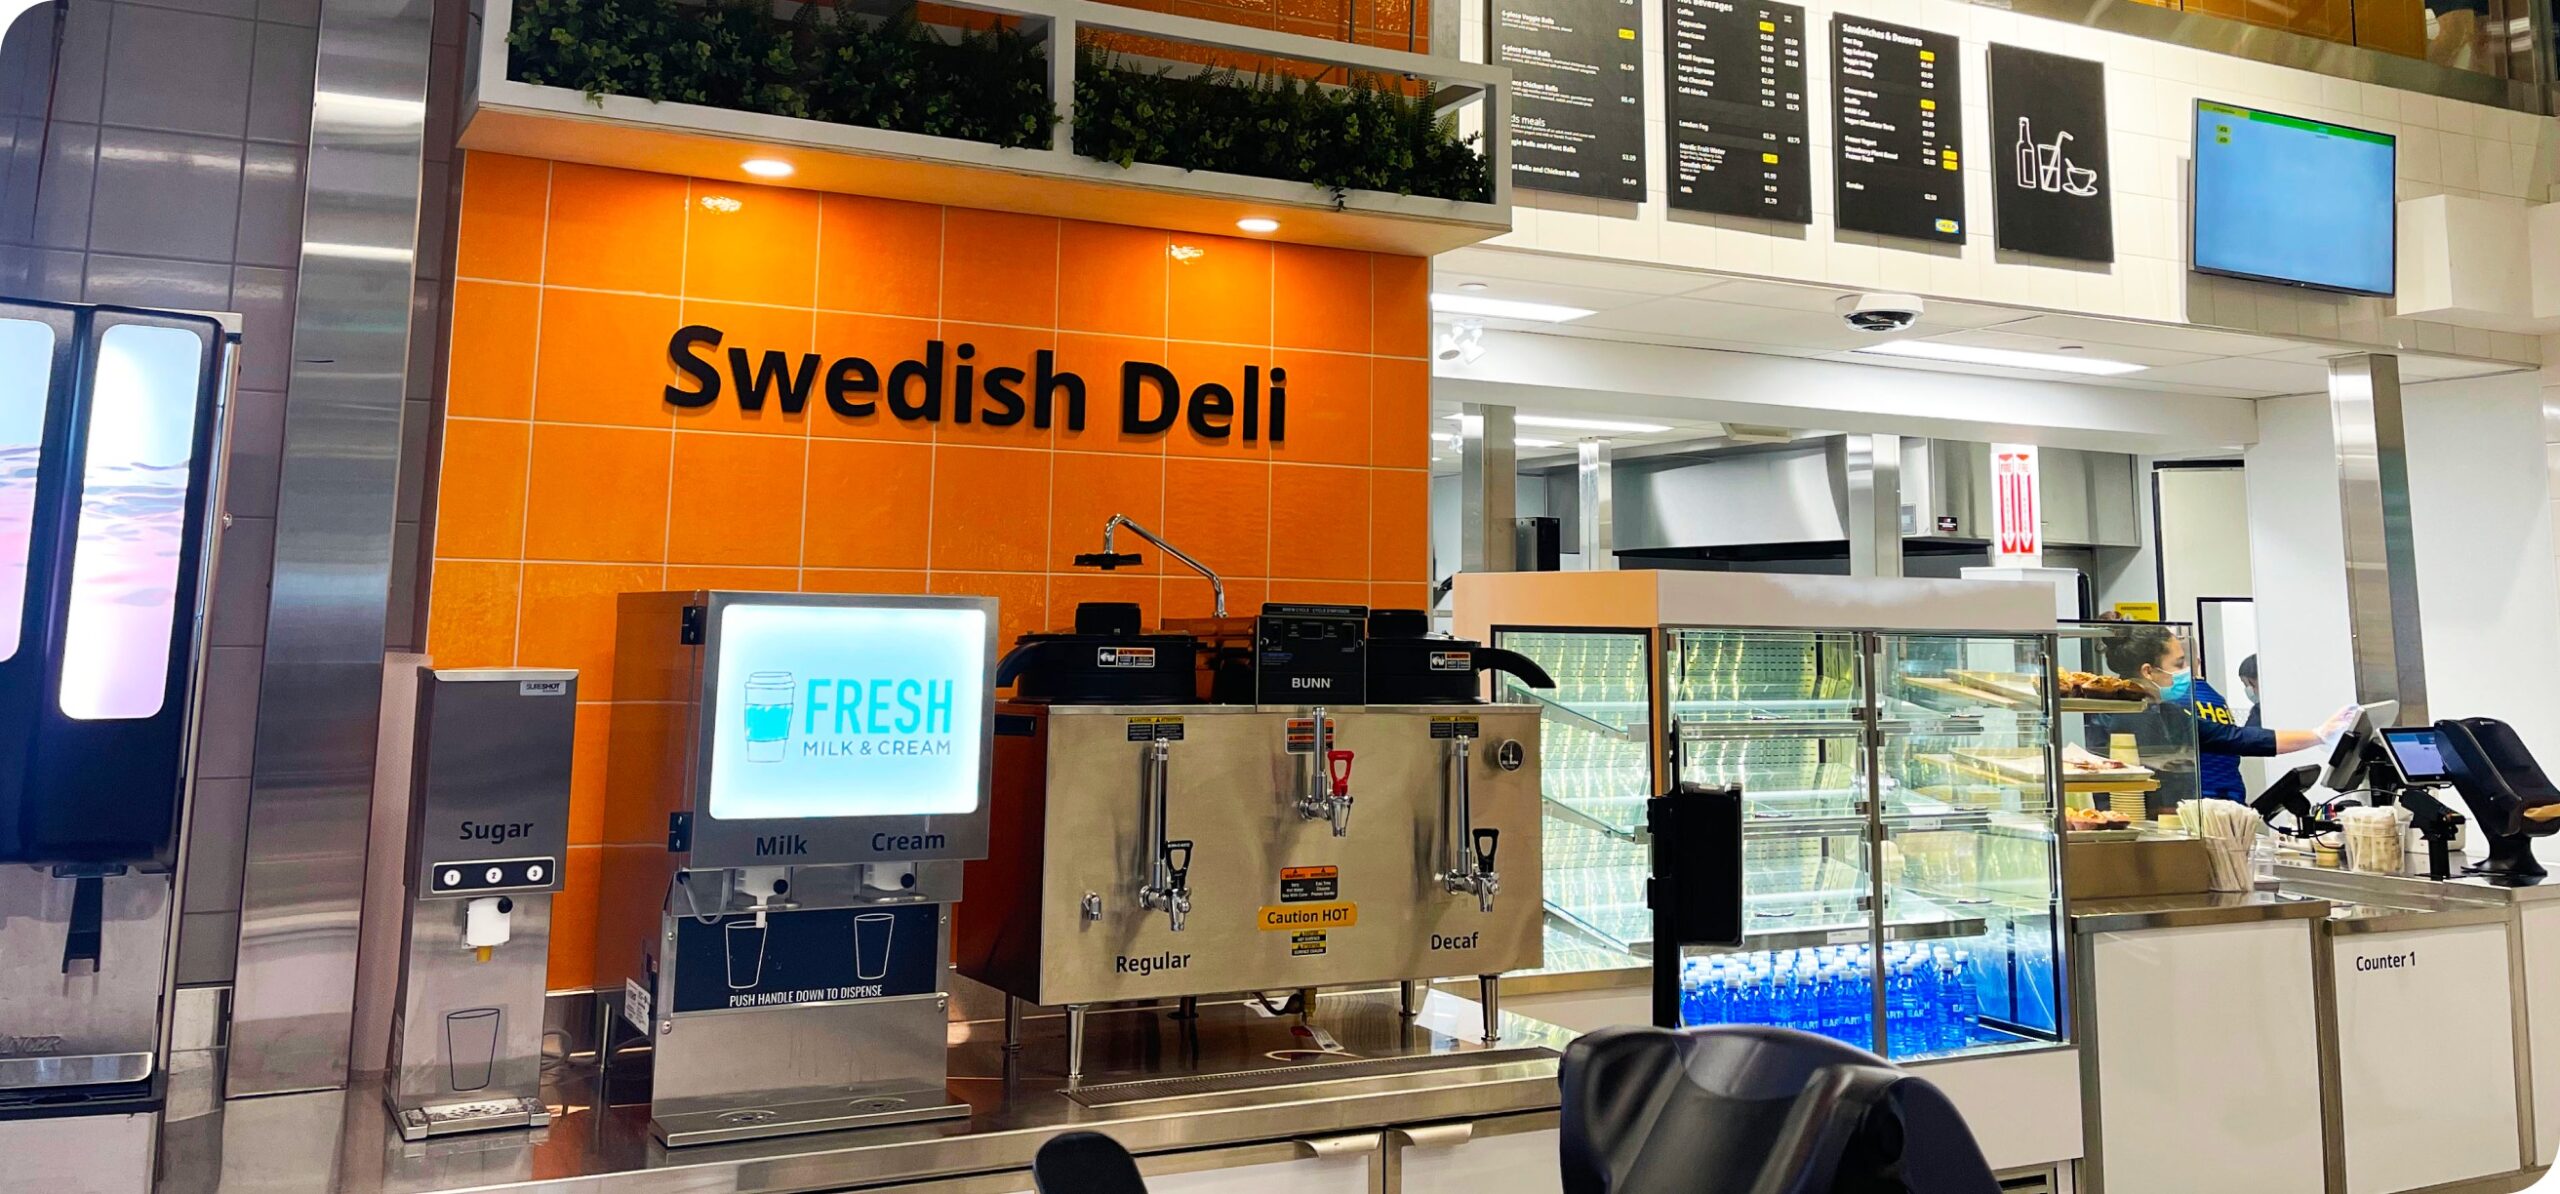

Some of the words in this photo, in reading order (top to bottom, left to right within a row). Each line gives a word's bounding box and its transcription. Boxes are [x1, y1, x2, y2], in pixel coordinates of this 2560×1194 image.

[1678, 8, 1694, 16] Coffee
[1843, 23, 1884, 40] Sandwiches
[1885, 31, 1891, 41] &
[1892, 33, 1923, 47] Desserts
[1511, 114, 1520, 124] ds
[1521, 116, 1546, 127] meals
[1699, 123, 1709, 132] Fog
[1511, 139, 1521, 147] ggie
[1523, 140, 1535, 148] Balls
[1548, 142, 1562, 152] Plant
[1544, 167, 1565, 176] Chicken
[662, 323, 1087, 432] Swedish
[1120, 360, 1288, 443] Deli
[1292, 678, 1330, 688] BUNN
[805, 679, 953, 735] FRESH
[803, 741, 853, 756] MILK
[860, 740, 872, 755] &
[878, 740, 951, 755] CREAM
[460, 821, 534, 844] Sugar
[756, 835, 808, 856] Milk
[872, 832, 945, 851] Cream
[1267, 910, 1318, 924] Caution
[1323, 908, 1349, 921] HOT
[1431, 932, 1479, 951] Decaf
[1116, 952, 1191, 976] Regular
[2356, 954, 2406, 971] Counter
[2410, 951, 2415, 966] 1
[730, 994, 755, 1007] PUSH
[758, 991, 793, 1005] HANDLE
[796, 989, 824, 1001] DOWN
[827, 988, 837, 999] TO
[841, 985, 882, 998] DISPENSE
